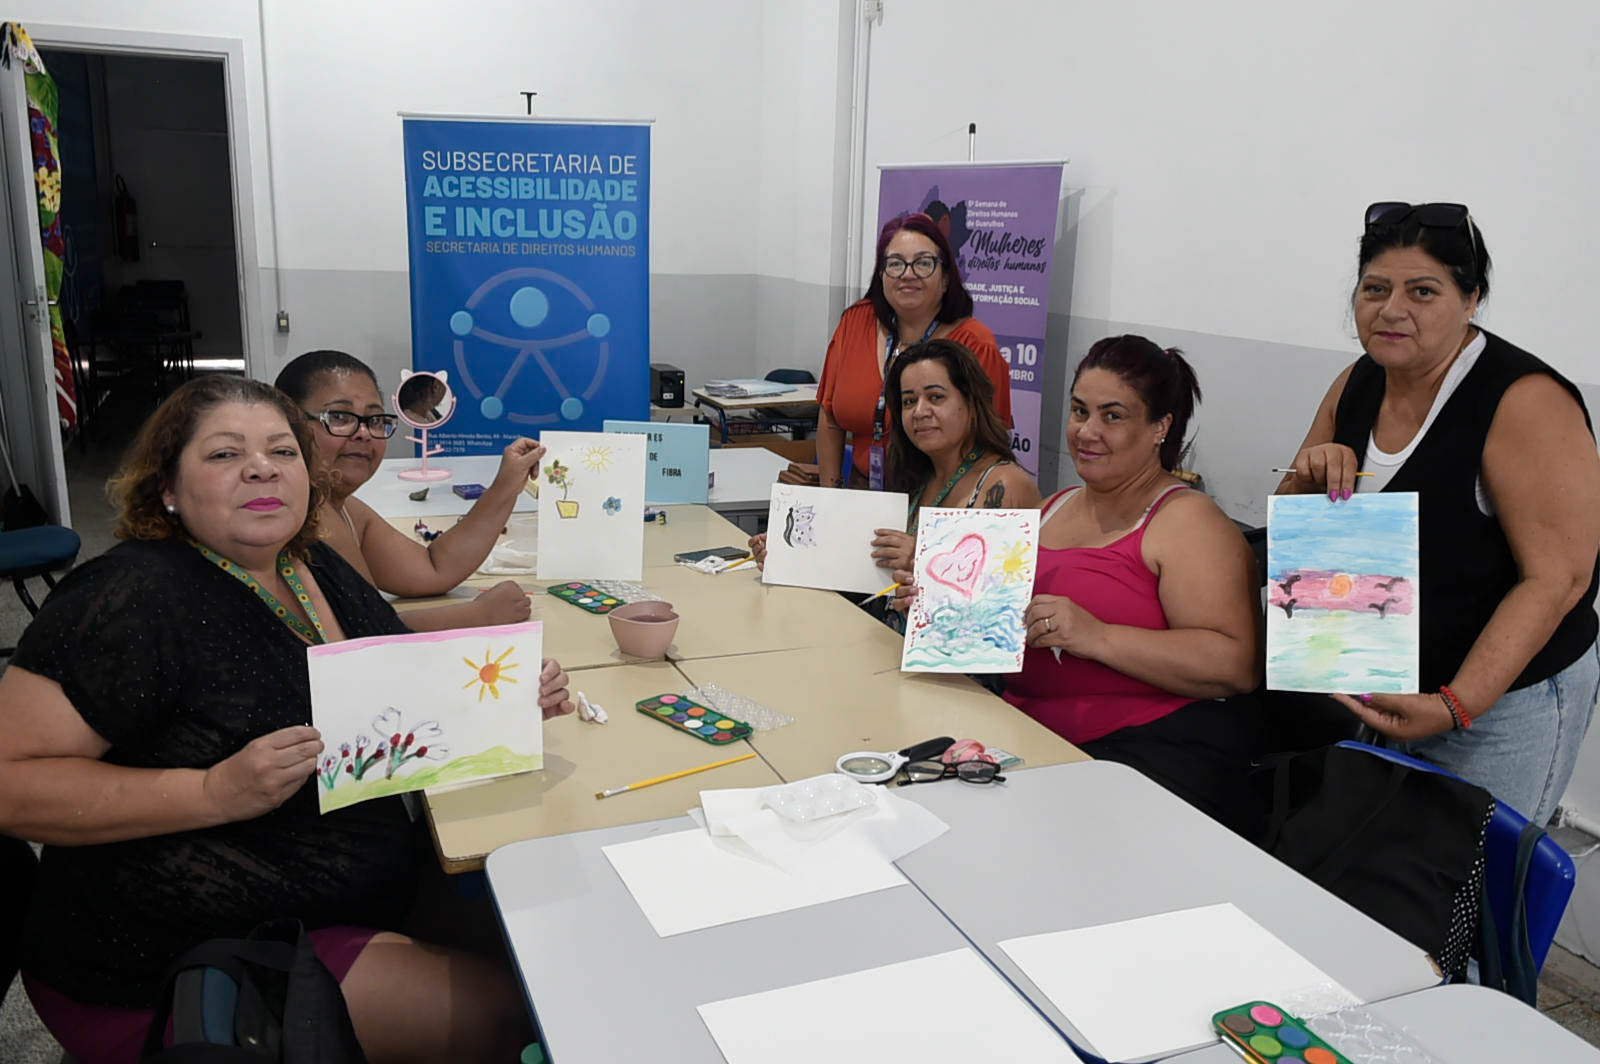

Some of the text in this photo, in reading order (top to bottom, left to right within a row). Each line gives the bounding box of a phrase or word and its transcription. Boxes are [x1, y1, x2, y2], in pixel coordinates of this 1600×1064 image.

[422, 150, 638, 175] SUBSECRETARIA DE
[423, 175, 638, 202] ACESSIBILIDADE
[975, 200, 998, 208] Semana
[999, 200, 1007, 208] de
[967, 210, 1018, 218] Direitos Humanos
[424, 203, 638, 240] E INCLUSÃO
[975, 220, 1005, 229] Guarulhos
[426, 240, 637, 257] SECRETARIA DE DIREITOS HUMANOS
[970, 230, 1046, 257] Mulheres
[968, 256, 999, 271] direitos
[1003, 257, 1046, 273] humanos
[988, 285, 1018, 294] JUSTIÇA
[1019, 286, 1025, 294] E
[1014, 297, 1040, 306] SOCIAL
[1016, 343, 1037, 366] 10
[649, 453, 658, 461] DE
[662, 468, 682, 477] FIBRA
